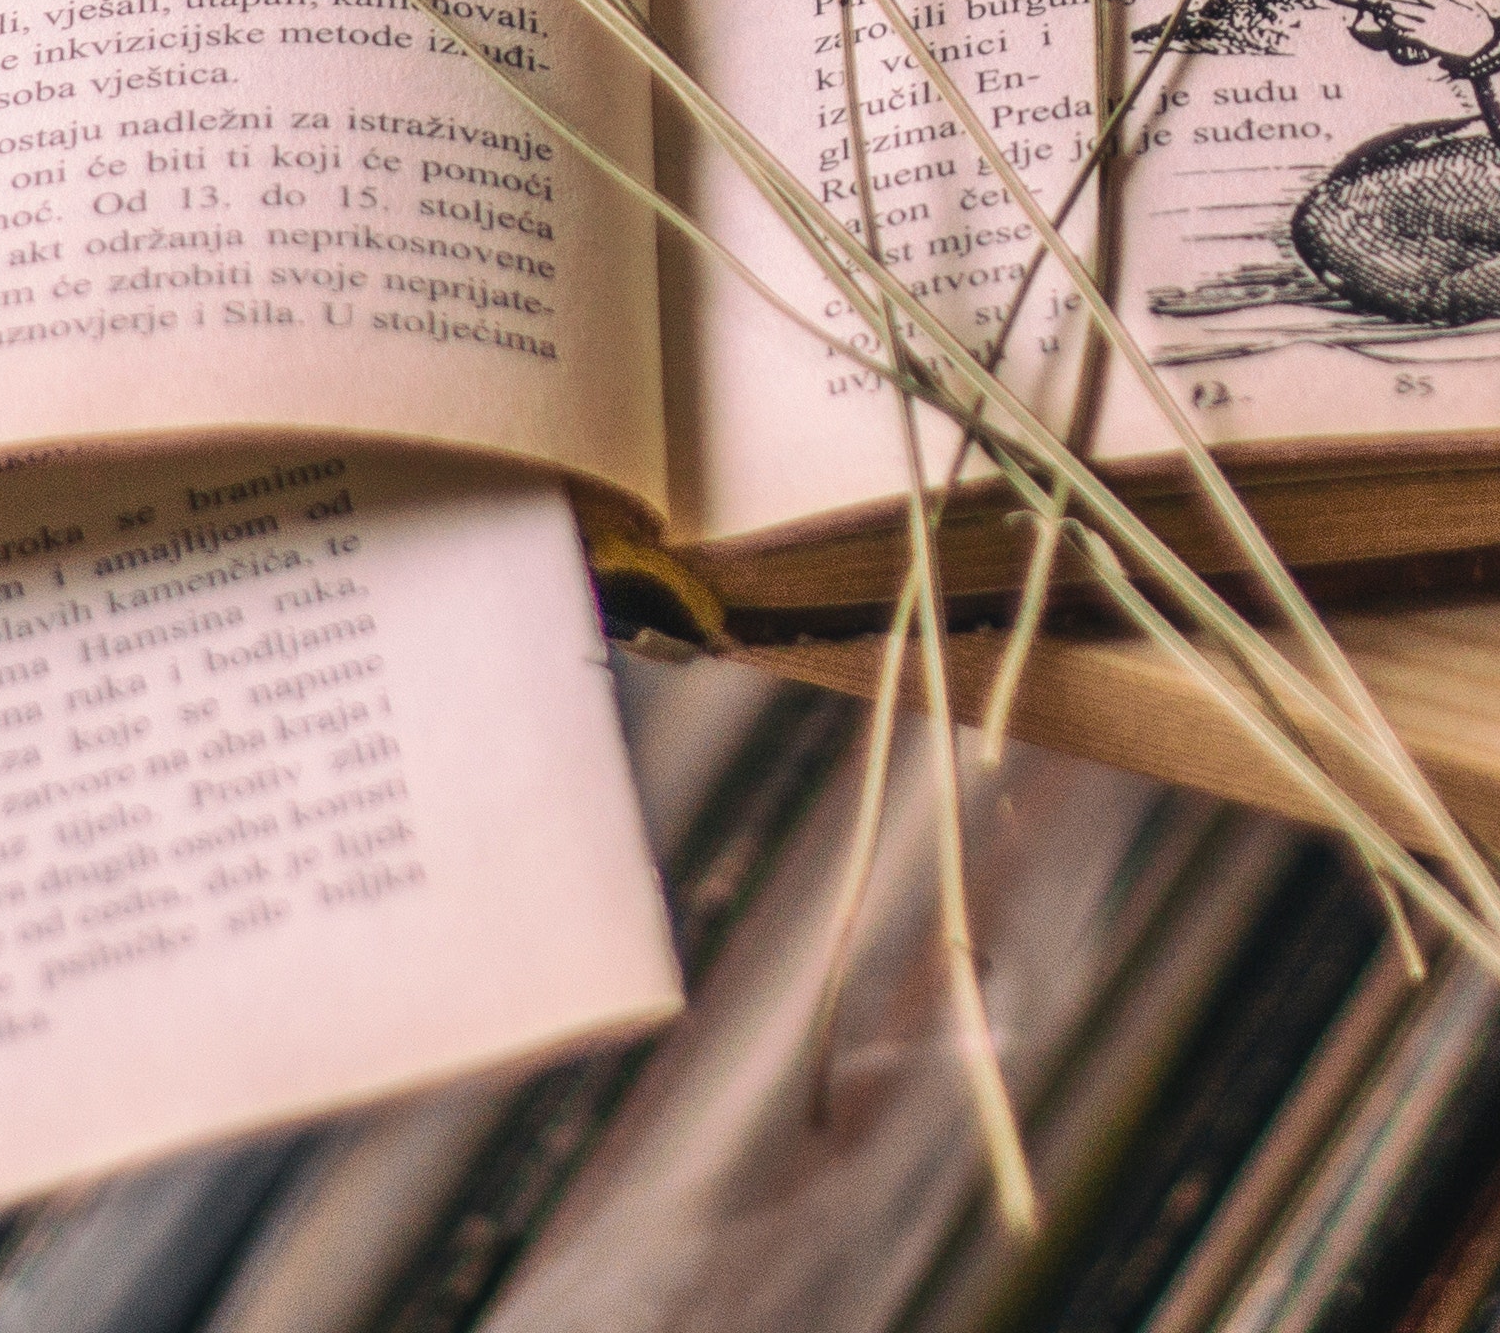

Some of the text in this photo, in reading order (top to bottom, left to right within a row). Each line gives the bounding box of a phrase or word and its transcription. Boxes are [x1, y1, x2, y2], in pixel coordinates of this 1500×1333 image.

[33, 20, 266, 66] inkvizicijske
[278, 23, 414, 50] metode
[89, 62, 240, 98] vještica.
[117, 105, 274, 137] nadležni
[289, 114, 331, 129] za
[346, 107, 554, 162] istraživanje
[9, 159, 67, 190] oni
[84, 154, 128, 179] će
[144, 146, 207, 173] biti
[225, 145, 252, 169] ti
[270, 144, 342, 176] koji
[357, 148, 403, 175] će
[419, 163, 554, 199] pomoći
[1394, 372, 1436, 398] 85
[116, 505, 154, 531] se
[187, 456, 346, 516] branimo
[53, 565, 67, 588] i
[92, 512, 280, 578] amajlijom
[307, 489, 354, 522] od
